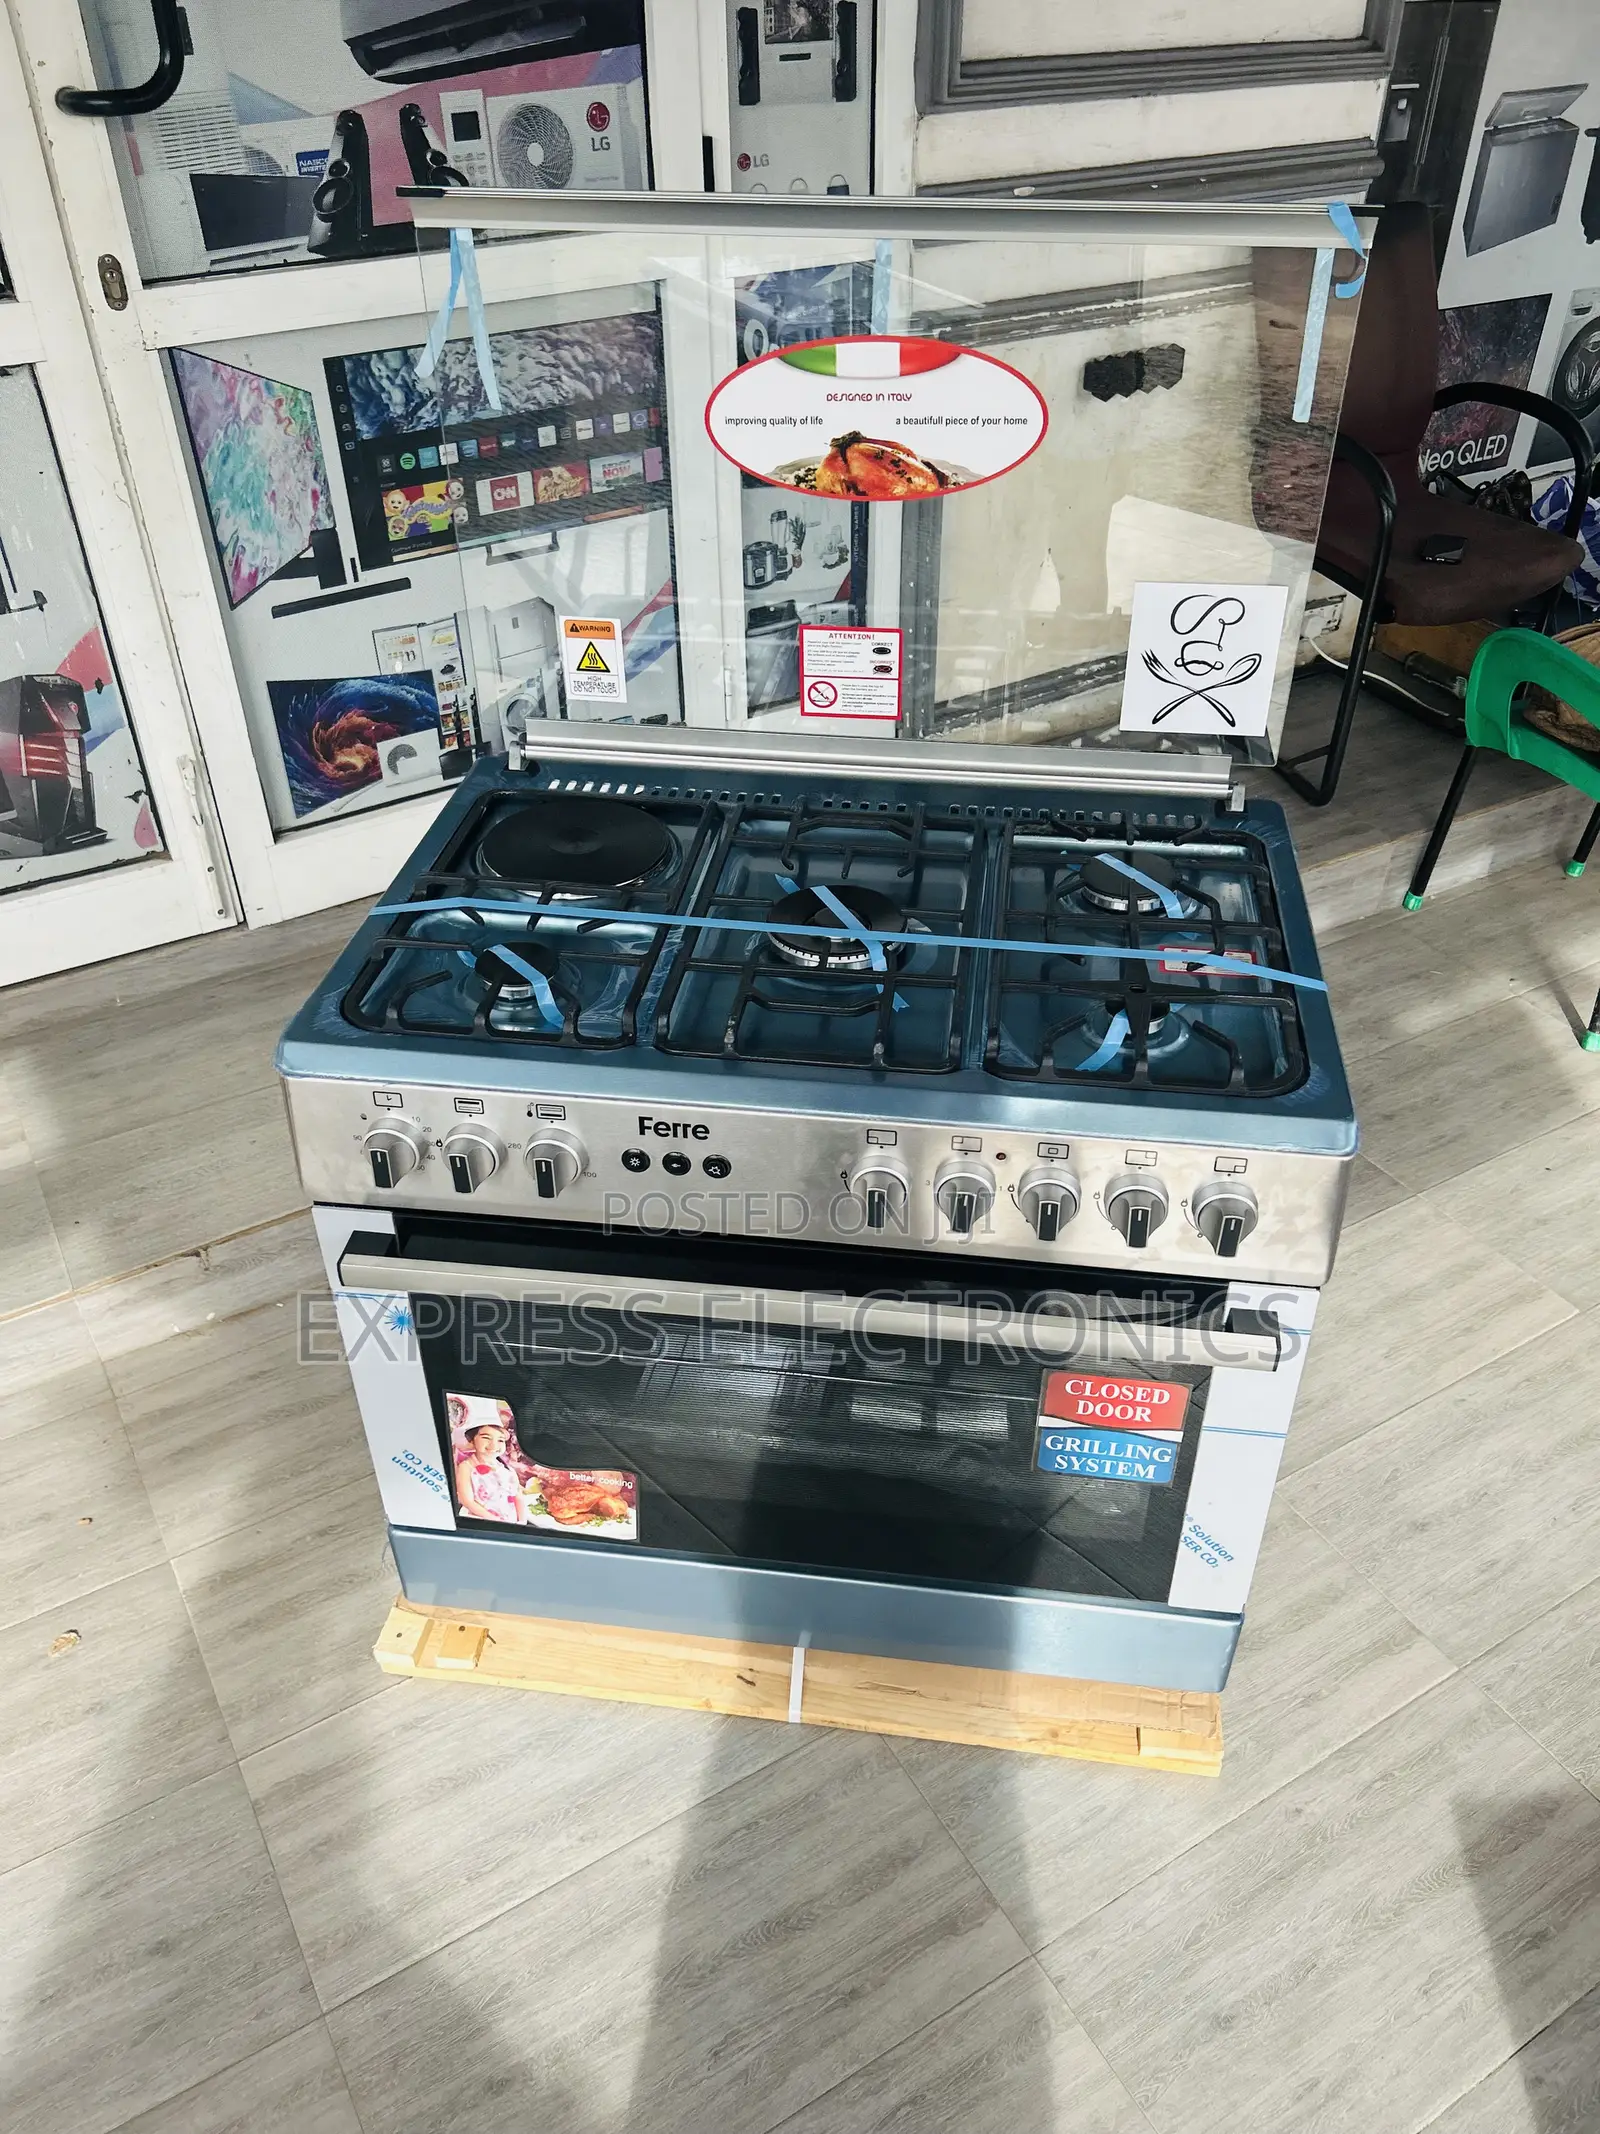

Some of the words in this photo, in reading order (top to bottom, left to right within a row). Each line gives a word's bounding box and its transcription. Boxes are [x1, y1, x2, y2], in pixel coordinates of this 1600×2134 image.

[590, 136, 611, 152] LG
[753, 153, 770, 168] LG
[300, 165, 327, 173] INVERTE
[826, 393, 873, 402] DESIGNED
[876, 394, 885, 402] IN
[887, 393, 912, 402] ITALY
[725, 416, 767, 427] improving
[769, 416, 797, 427] quality
[799, 416, 809, 425] of
[810, 416, 823, 425] life
[895, 417, 901, 425] a
[903, 416, 943, 425] beautifull
[945, 416, 968, 427] piece
[970, 416, 980, 425] of
[981, 417, 1001, 427] your
[1003, 416, 1028, 425] home
[1457, 434, 1508, 466] QLED
[602, 465, 631, 479] NOW
[492, 485, 517, 501] CNN
[579, 625, 611, 633] WARNING
[828, 633, 875, 641] ATTENTION!
[573, 680, 616, 689] TEMPERATURE
[638, 1115, 710, 1141] Ferre
[507, 1142, 522, 1150] 280
[1064, 1379, 1171, 1405] CLOSED
[1075, 1400, 1152, 1423] DOOR
[1045, 1435, 1172, 1463] GRILLING
[391, 1456, 443, 1493] Solution
[423, 1464, 447, 1484] SER
[1054, 1454, 1157, 1480] SYSTEM
[569, 1471, 596, 1483] better
[599, 1477, 633, 1489] cooking
[1180, 1532, 1202, 1553] SER
[1188, 1524, 1235, 1562] Solution
